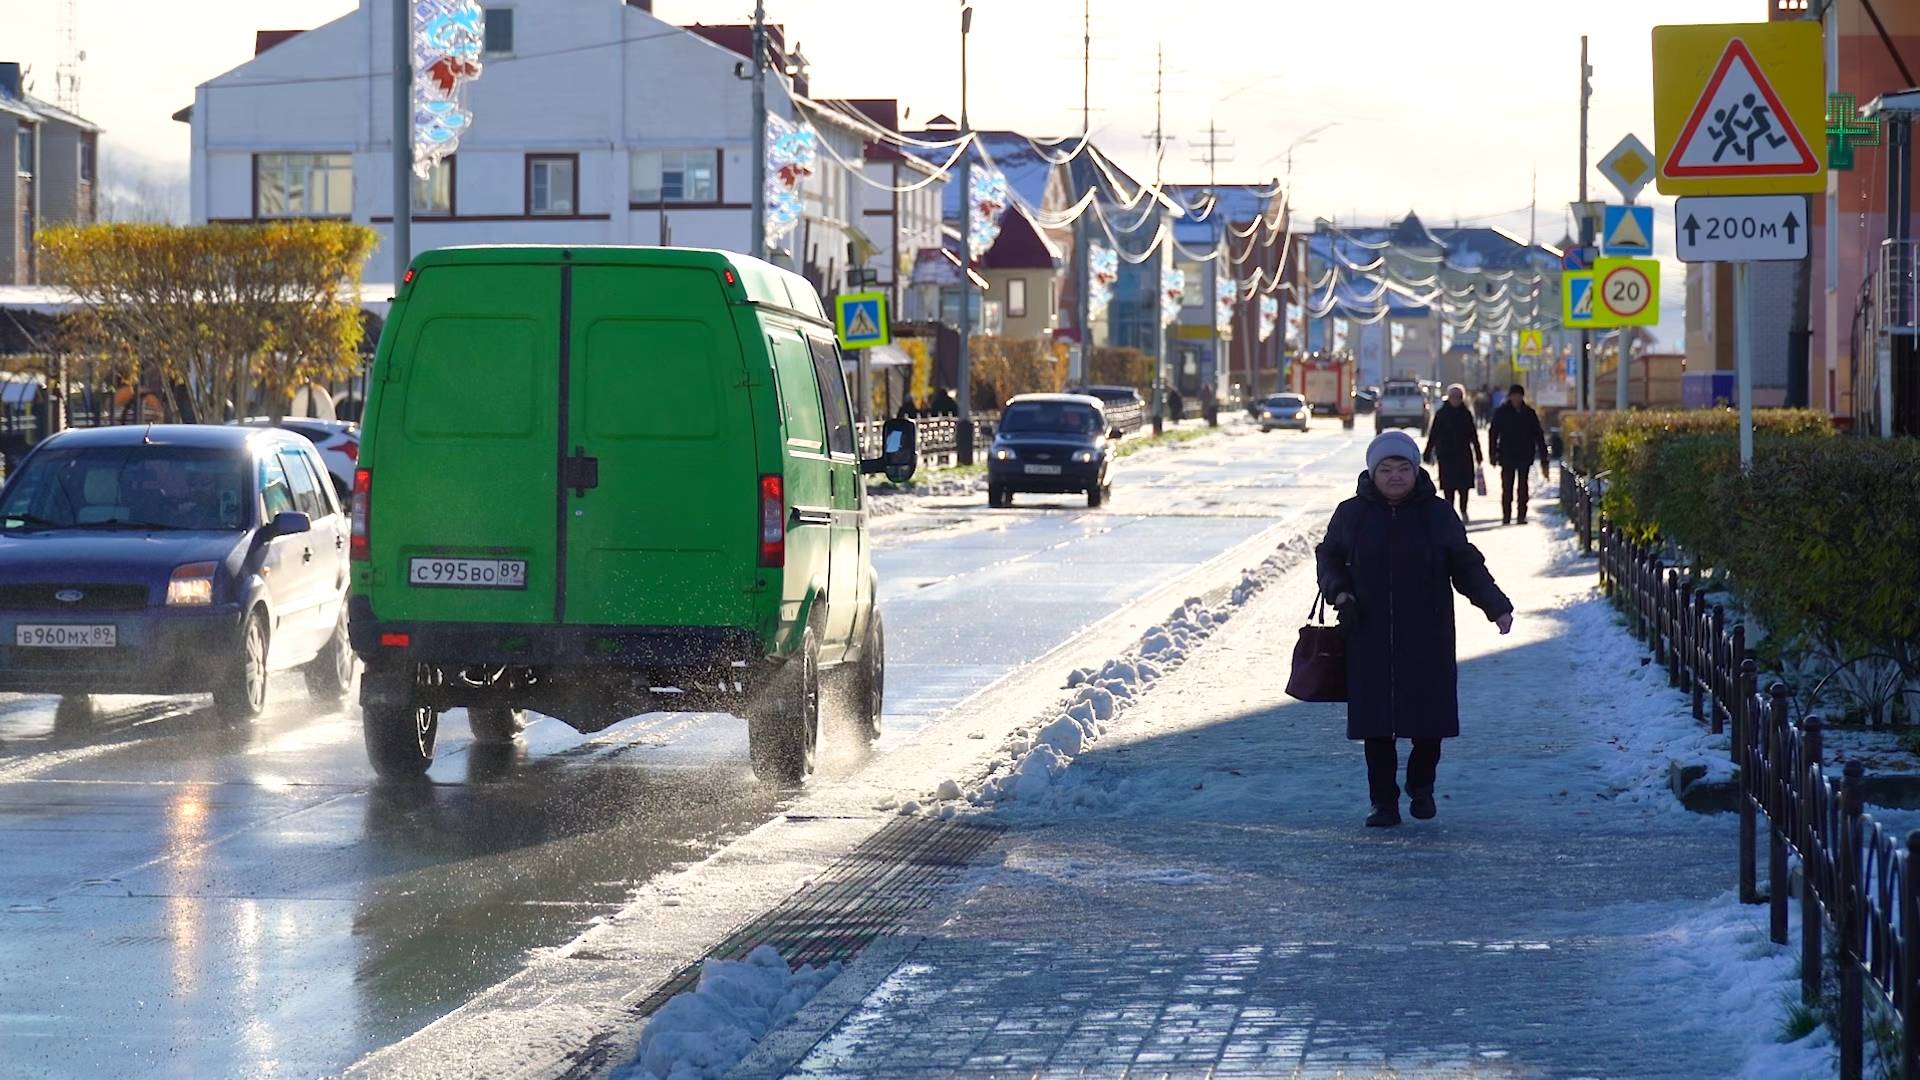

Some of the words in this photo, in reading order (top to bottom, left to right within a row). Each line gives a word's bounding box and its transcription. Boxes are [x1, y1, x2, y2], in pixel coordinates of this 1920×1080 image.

[1613, 281, 1639, 301] 20
[500, 563, 520, 577] 89
[94, 627, 110, 640] 89
